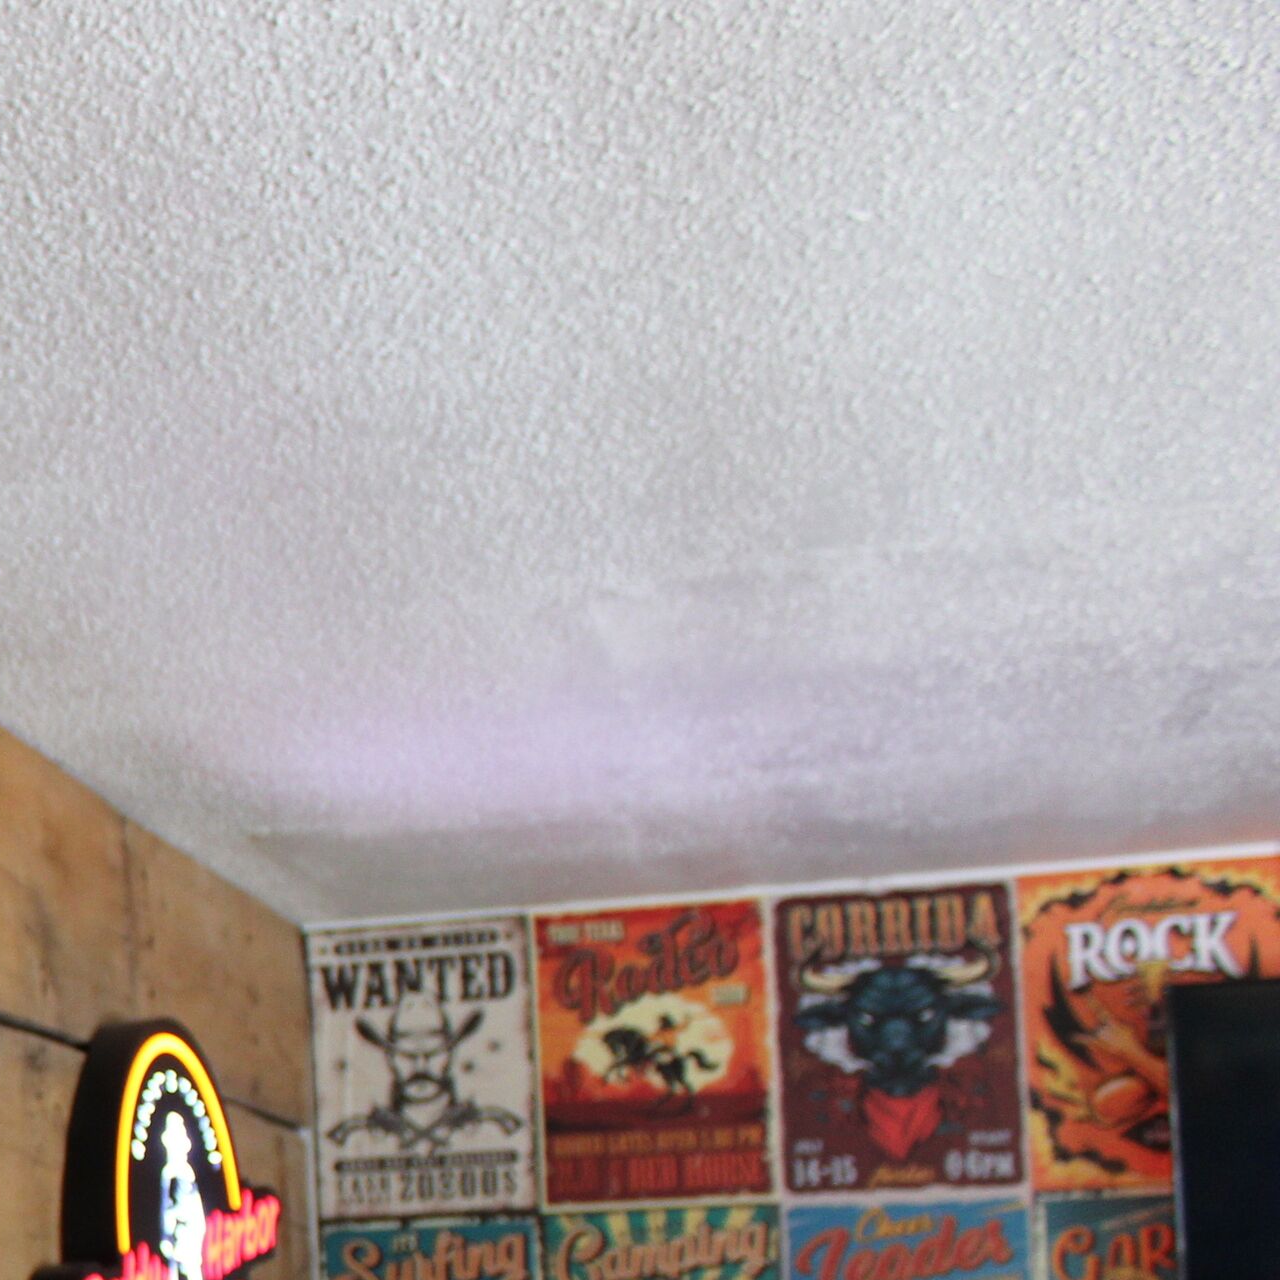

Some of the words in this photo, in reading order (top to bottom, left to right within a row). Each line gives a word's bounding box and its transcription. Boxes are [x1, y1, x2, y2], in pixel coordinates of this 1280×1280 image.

[788, 893, 1002, 960] CORRIDA
[1065, 911, 1242, 988] ROCK
[319, 951, 517, 1012] WANTED
